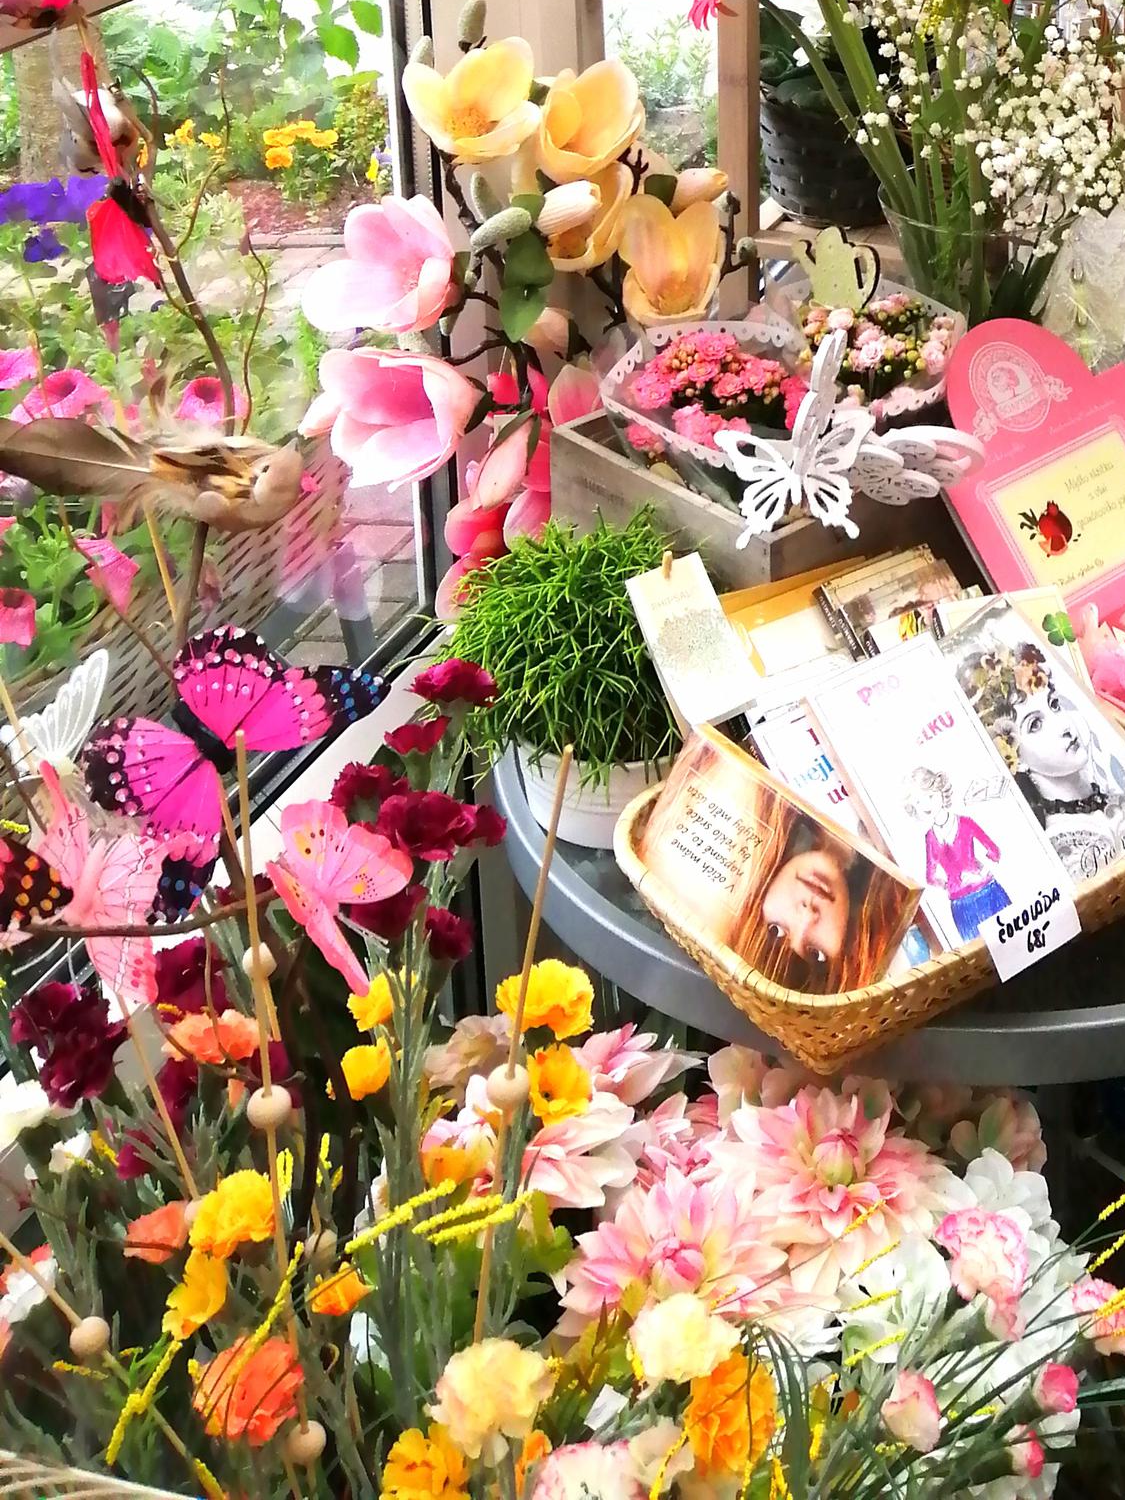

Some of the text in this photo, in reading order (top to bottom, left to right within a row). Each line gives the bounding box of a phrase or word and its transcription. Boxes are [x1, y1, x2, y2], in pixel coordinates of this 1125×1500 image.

[838, 618, 857, 651] TIRAMISU
[707, 801, 733, 823] mělo
[676, 823, 690, 835] co
[711, 828, 738, 852] řeklo
[732, 819, 765, 849] kdyby
[670, 838, 702, 864] máme
[701, 845, 745, 878] napsané
[737, 846, 752, 863] by
[1080, 842, 1119, 879] Pro
[701, 861, 728, 885] očích
